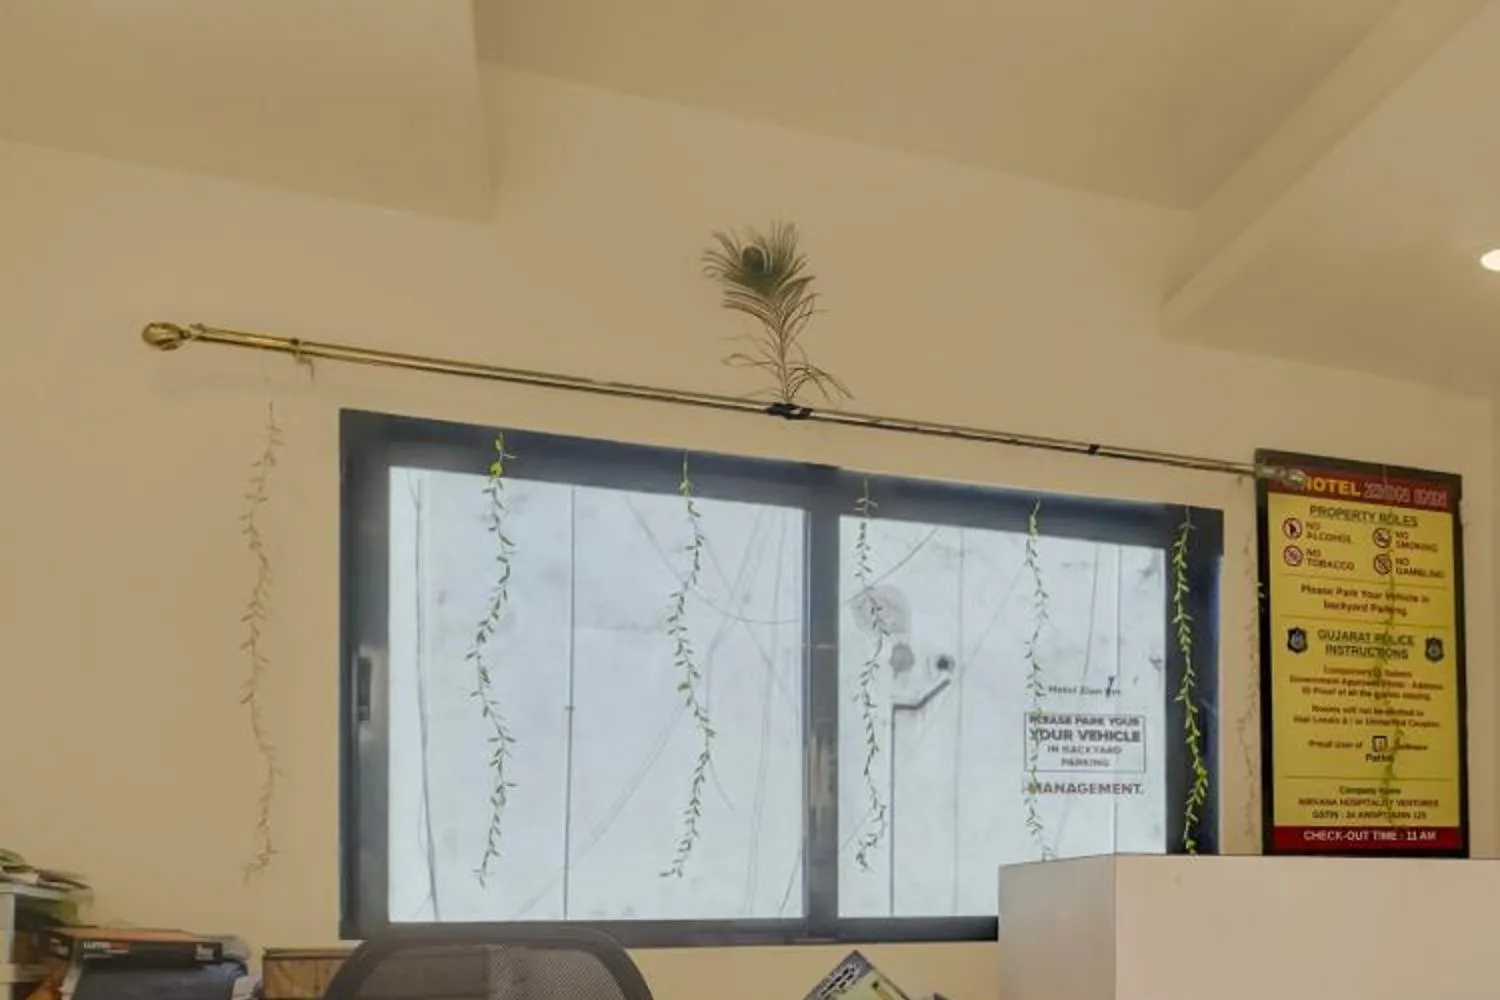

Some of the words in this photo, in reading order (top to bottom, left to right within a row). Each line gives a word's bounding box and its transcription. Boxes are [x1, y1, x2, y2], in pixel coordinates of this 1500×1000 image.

[1309, 505, 1376, 525] PROPERTY
[1307, 521, 1321, 531] NO
[1307, 558, 1355, 572] TOBACCO
[1395, 557, 1410, 567] NO
[1317, 629, 1371, 643] GUJARAT
[1325, 644, 1409, 660] INSTRUCTIONS
[1029, 728, 1073, 742] YOUR
[1078, 729, 1141, 743] VEHICLE
[1303, 830, 1369, 841] CHECK-OUT
[1373, 831, 1398, 841] TIME
